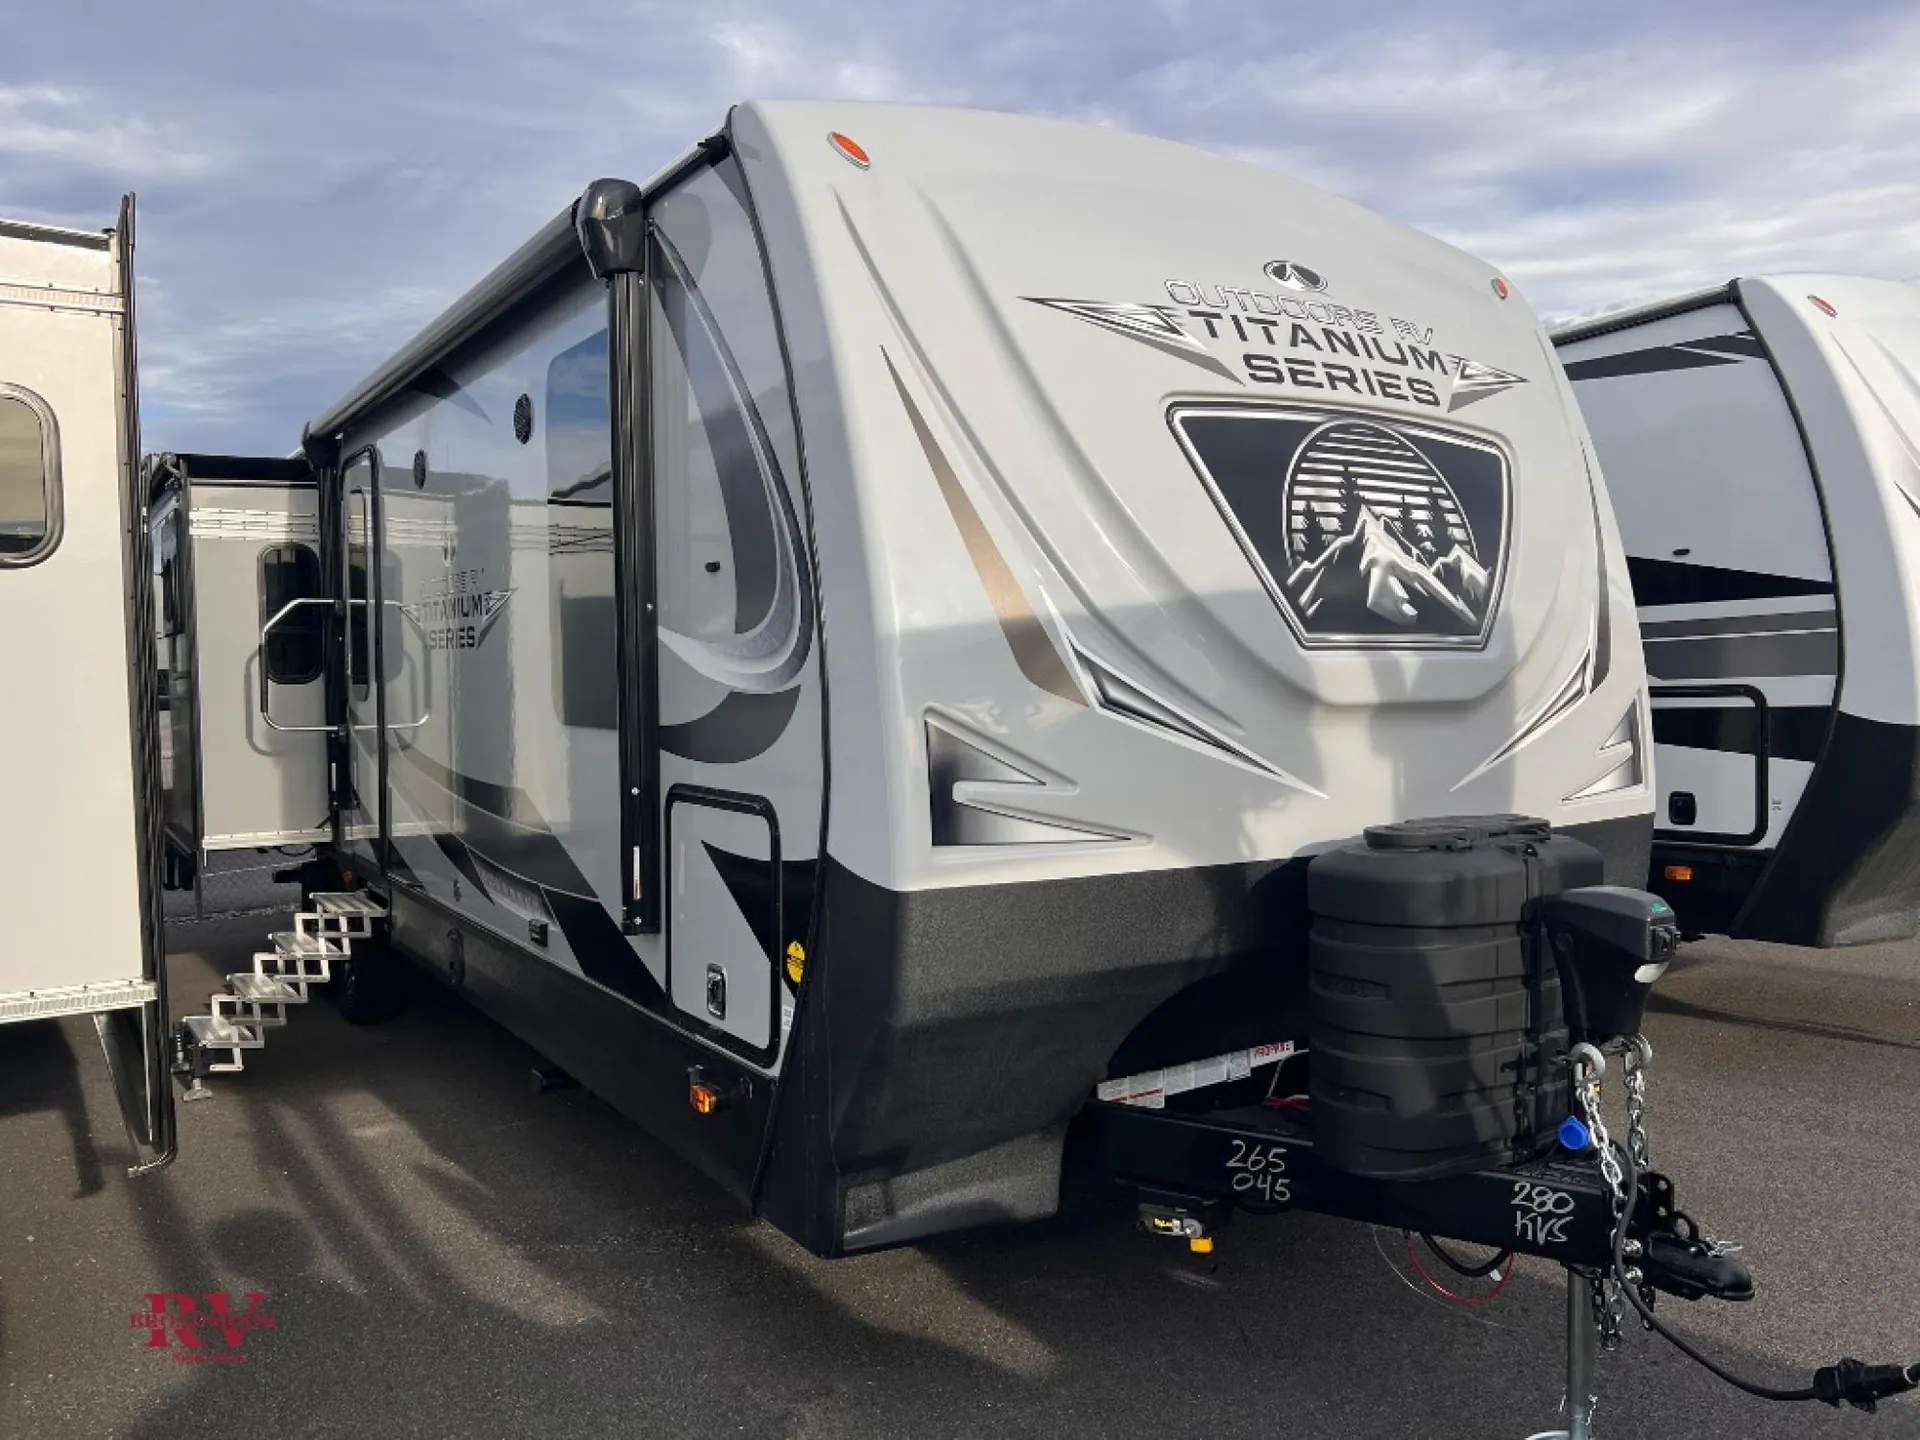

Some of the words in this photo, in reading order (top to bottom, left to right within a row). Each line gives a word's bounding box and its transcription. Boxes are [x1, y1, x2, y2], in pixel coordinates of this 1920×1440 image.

[1164, 278, 1383, 335] OUTDOORS
[1389, 316, 1433, 346] RV
[1188, 309, 1449, 376] TITANIUM
[1242, 353, 1441, 407] SERIES
[421, 593, 482, 622] TITANIUM
[428, 626, 475, 650] SERIES
[1226, 1140, 1287, 1172] 265
[1231, 1173, 1291, 1201] 045
[1511, 1181, 1576, 1214] 280
[1514, 1210, 1574, 1246] KVS
